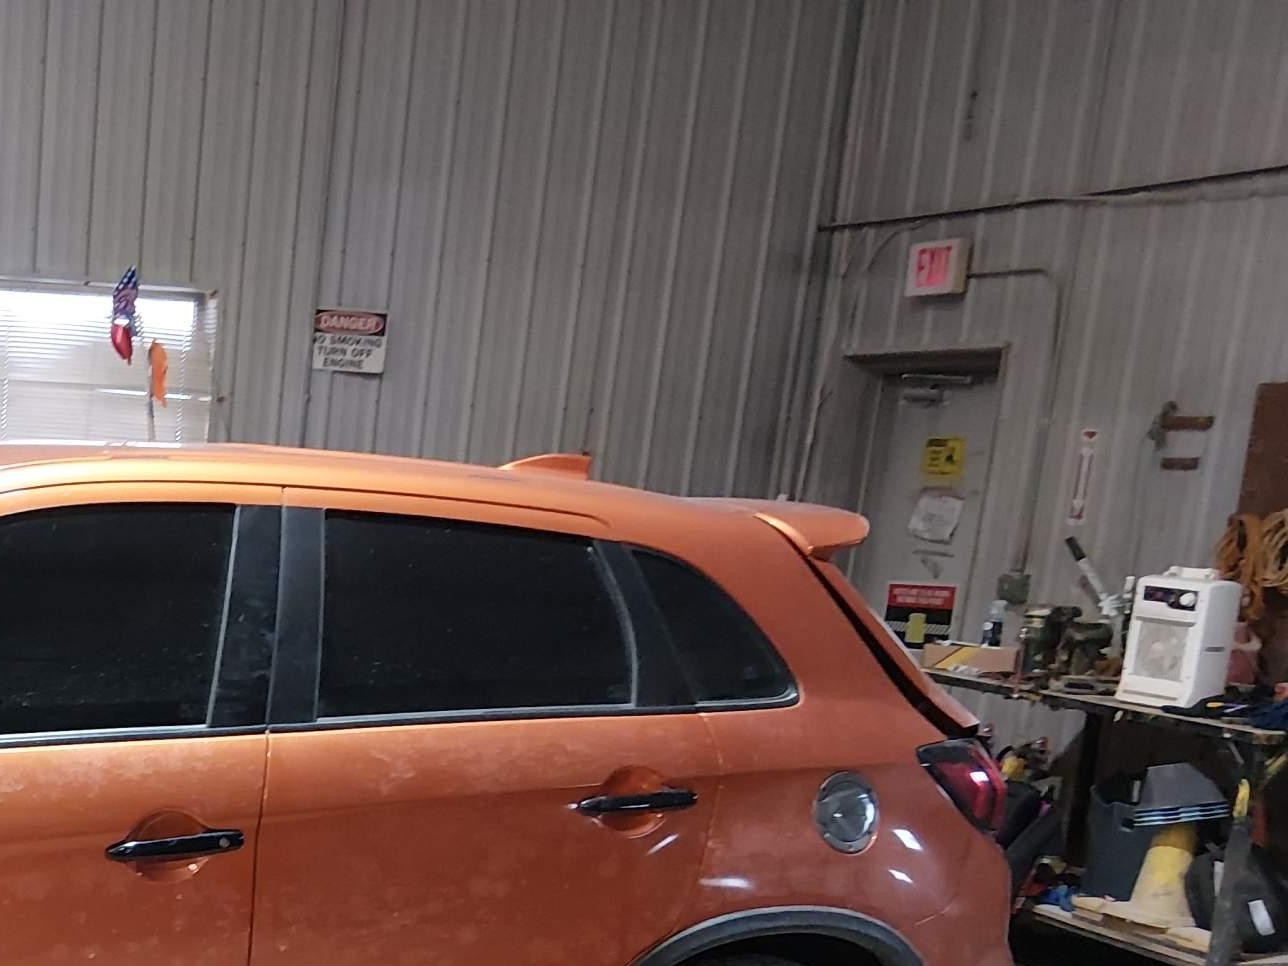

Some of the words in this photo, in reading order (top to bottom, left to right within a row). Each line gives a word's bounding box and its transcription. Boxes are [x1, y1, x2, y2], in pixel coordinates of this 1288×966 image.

[320, 315, 376, 331] DANGER
[318, 346, 347, 357] TURN
[351, 348, 373, 358] OFF
[323, 357, 364, 369] ENGINE
